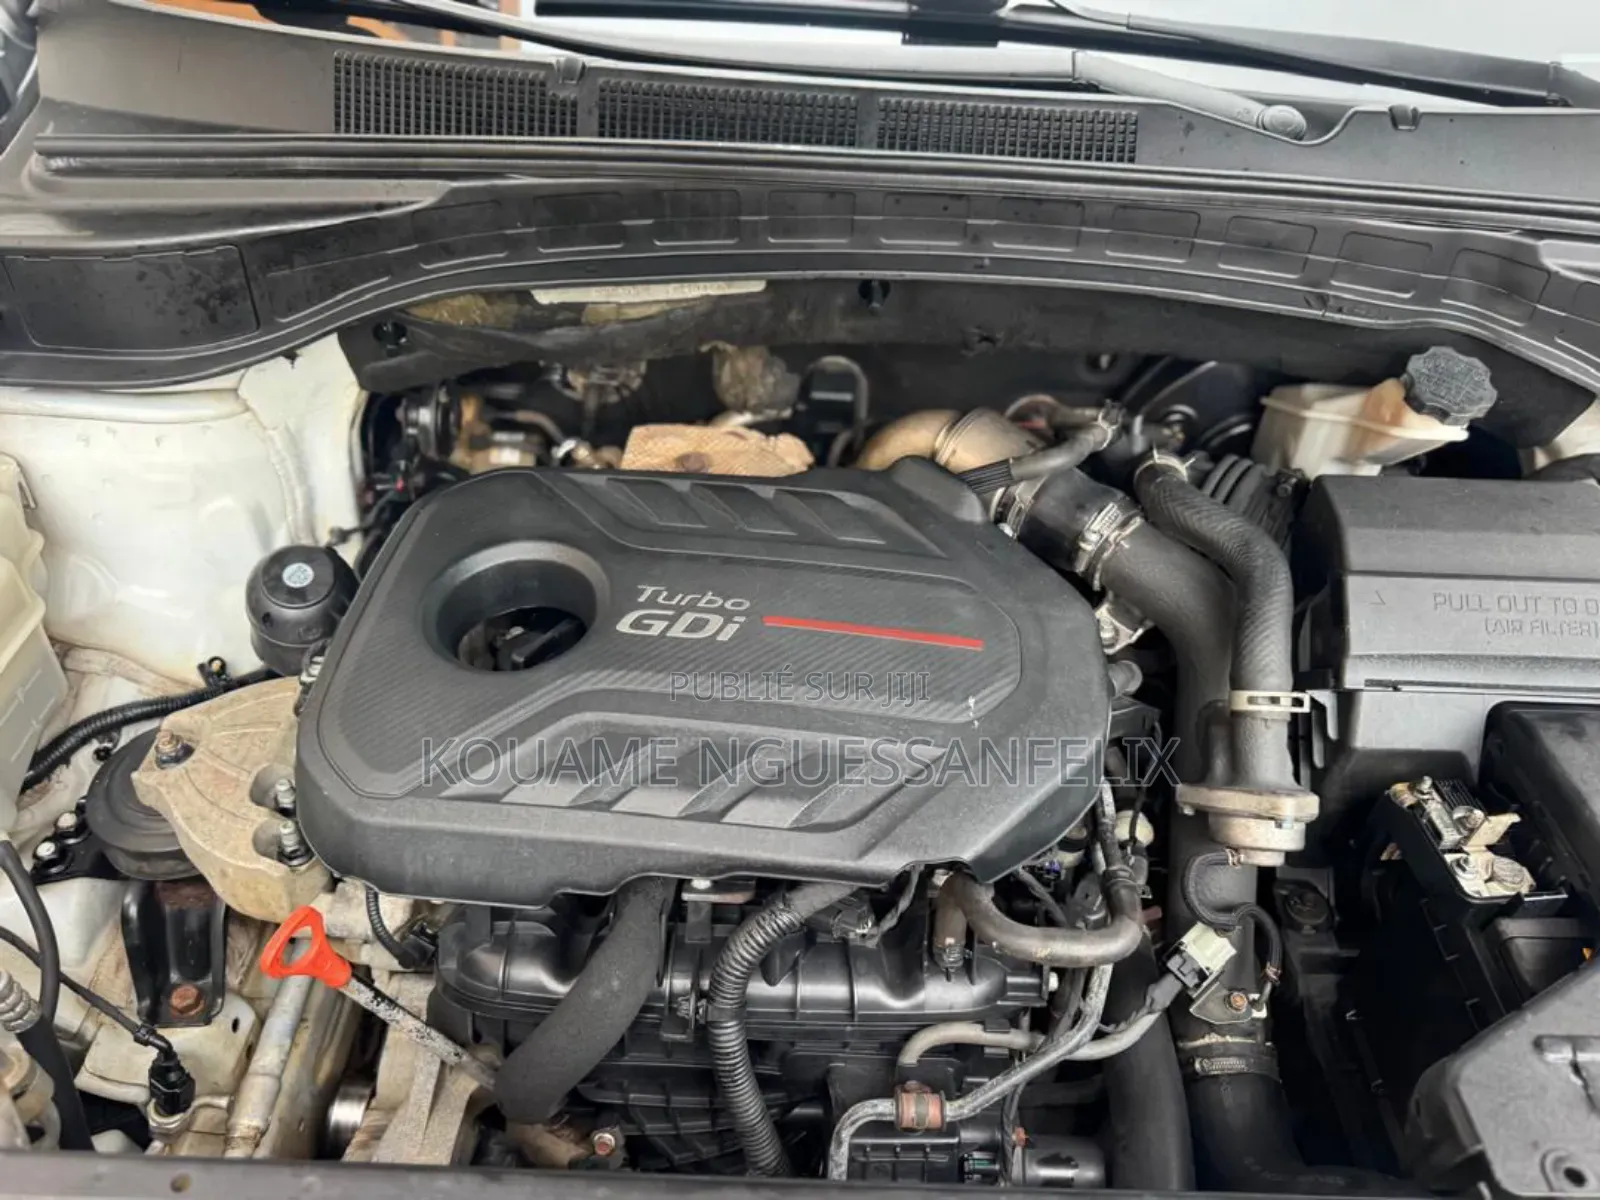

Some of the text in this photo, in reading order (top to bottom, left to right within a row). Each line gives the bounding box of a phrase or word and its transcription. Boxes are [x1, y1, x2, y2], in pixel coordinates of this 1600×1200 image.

[637, 584, 750, 611] Turbo
[1433, 592, 1490, 612] PULL
[1497, 595, 1541, 614] OUT
[1547, 597, 1578, 616] TO
[615, 609, 746, 641] GDi
